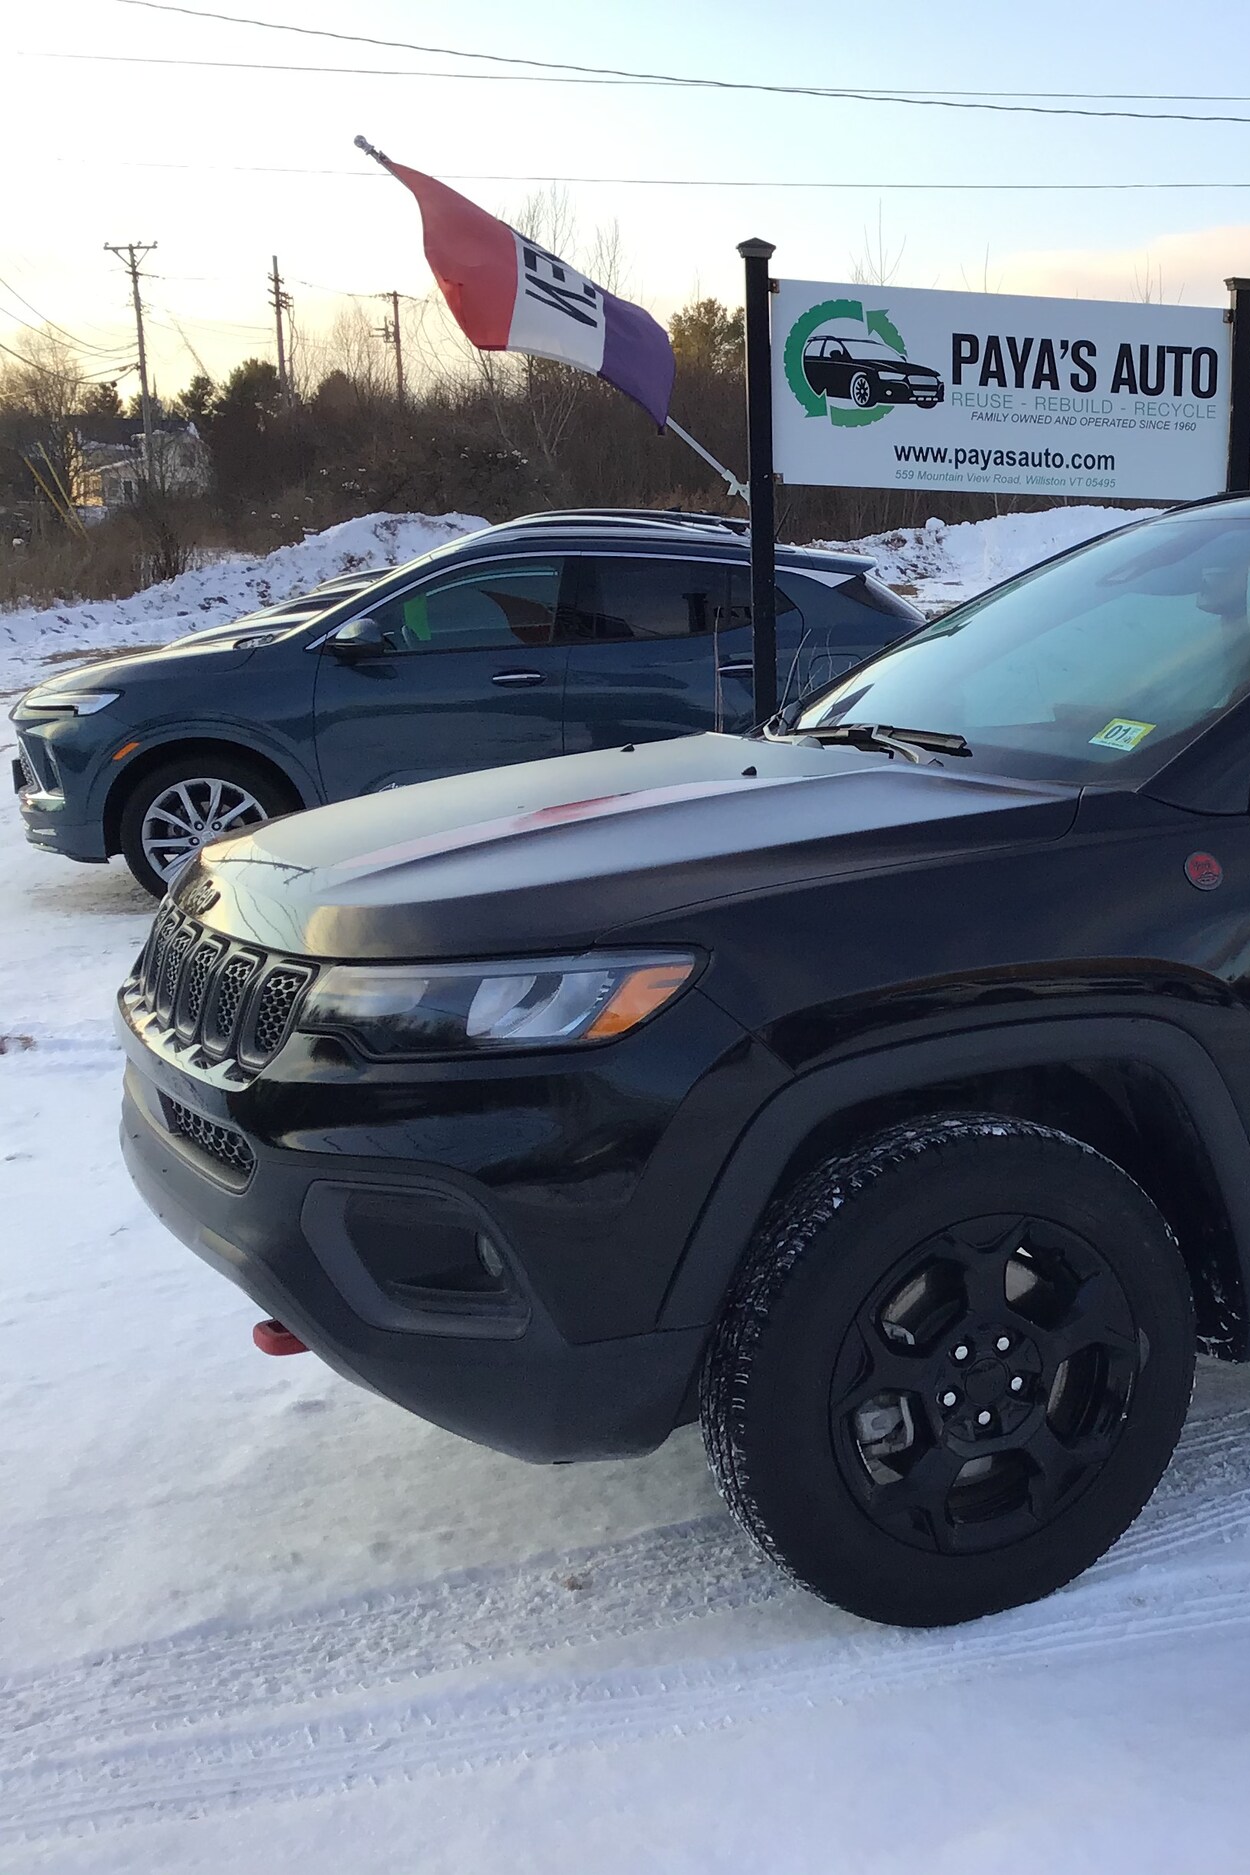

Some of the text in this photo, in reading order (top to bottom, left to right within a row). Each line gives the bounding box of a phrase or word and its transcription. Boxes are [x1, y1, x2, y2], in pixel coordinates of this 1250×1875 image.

[952, 333, 1218, 399] PAYA'S AUTO
[951, 392, 1013, 409] REUSE
[1035, 396, 1113, 414] REBUILD
[1134, 401, 1217, 419] RECYCLE
[970, 411, 1197, 431] FAMILY OWNED AND OPERATED SINCE 1960
[894, 445, 1115, 471] www.payasauto.com
[895, 470, 914, 480] 559
[917, 471, 963, 482] Mountain
[967, 473, 990, 482] View
[1026, 475, 1066, 486] Williston
[1069, 477, 1084, 486] VT
[1085, 478, 1116, 488] 05495
[1104, 725, 1132, 741] 01
